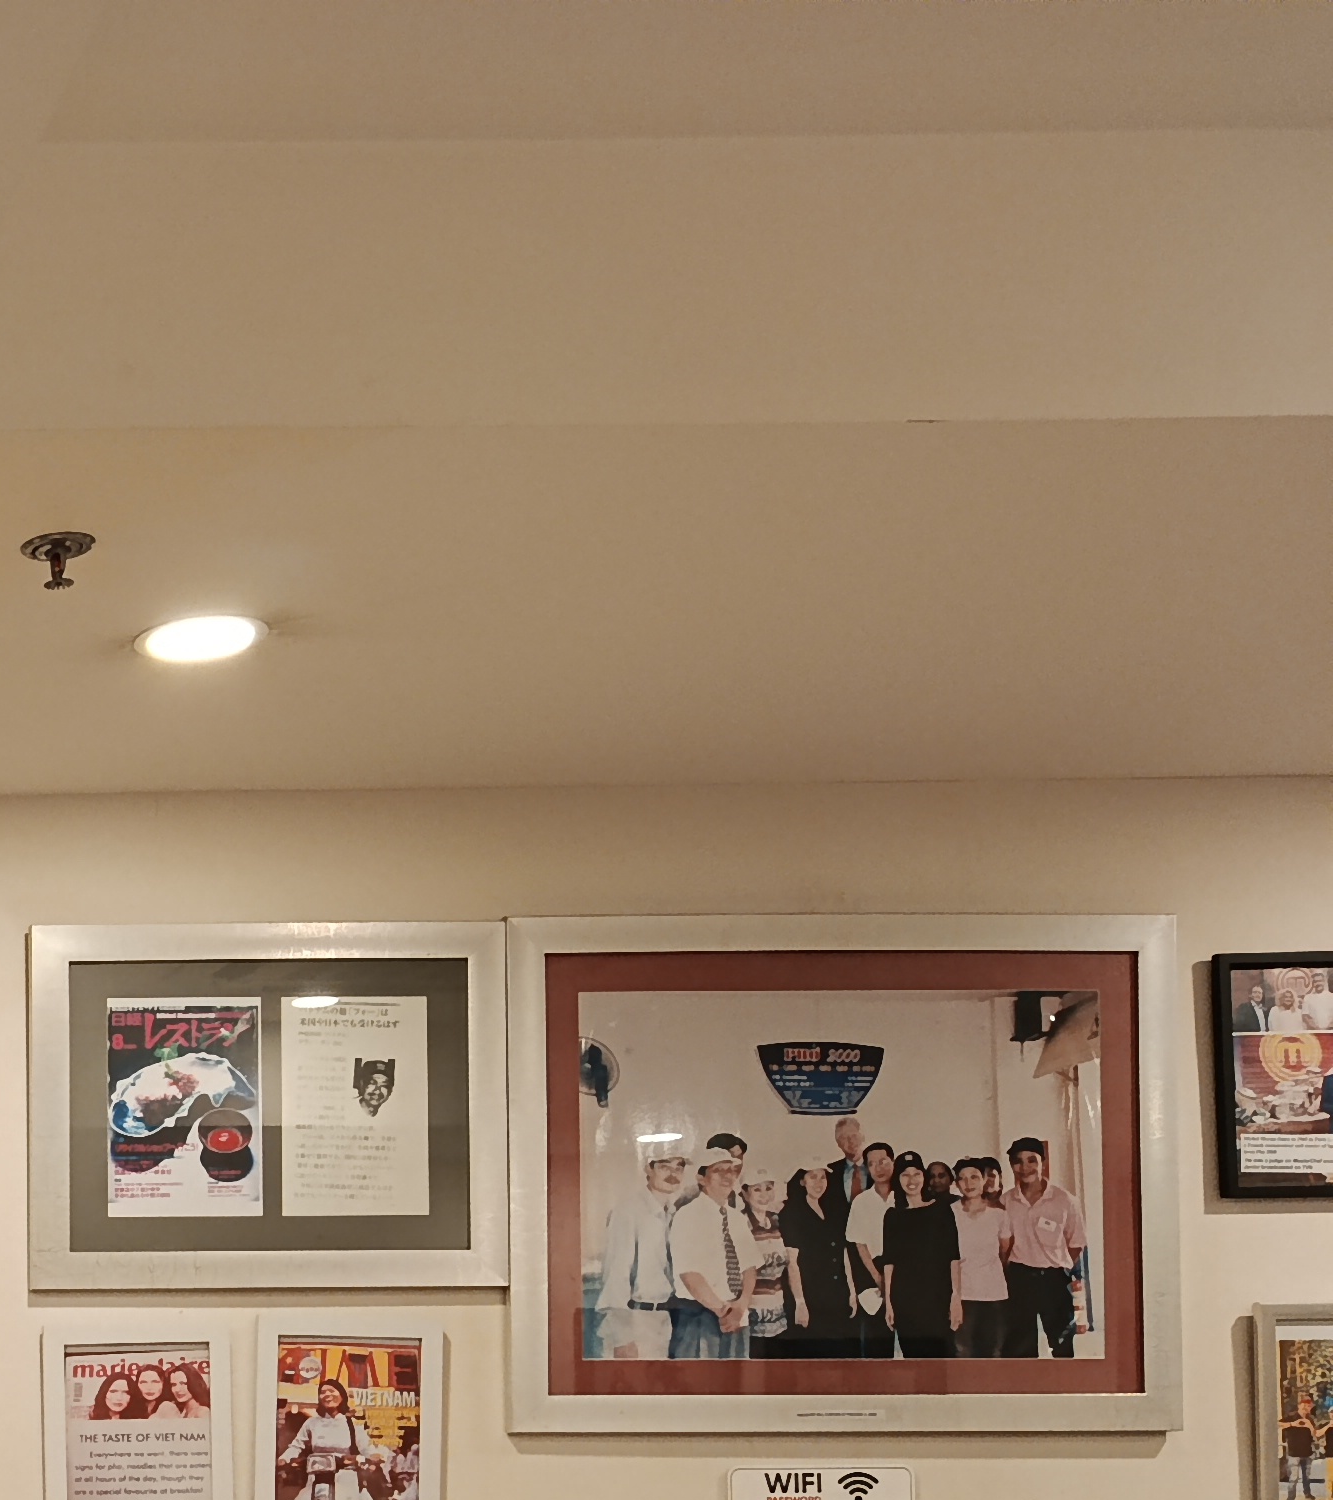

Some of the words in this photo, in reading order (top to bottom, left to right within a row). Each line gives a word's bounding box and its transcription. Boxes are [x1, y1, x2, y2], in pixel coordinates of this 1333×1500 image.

[144, 1011, 251, 1049] レストラン
[827, 1049, 860, 1062] 2000
[73, 1359, 141, 1378] marie
[354, 1390, 415, 1407] VIETNAM
[79, 1434, 98, 1443] THE
[102, 1434, 132, 1442] TASTE
[135, 1433, 151, 1442] OF
[155, 1432, 175, 1441] VIET
[180, 1432, 206, 1441] NAM
[764, 1472, 822, 1493] WIFI
[96, 1488, 121, 1496] special
